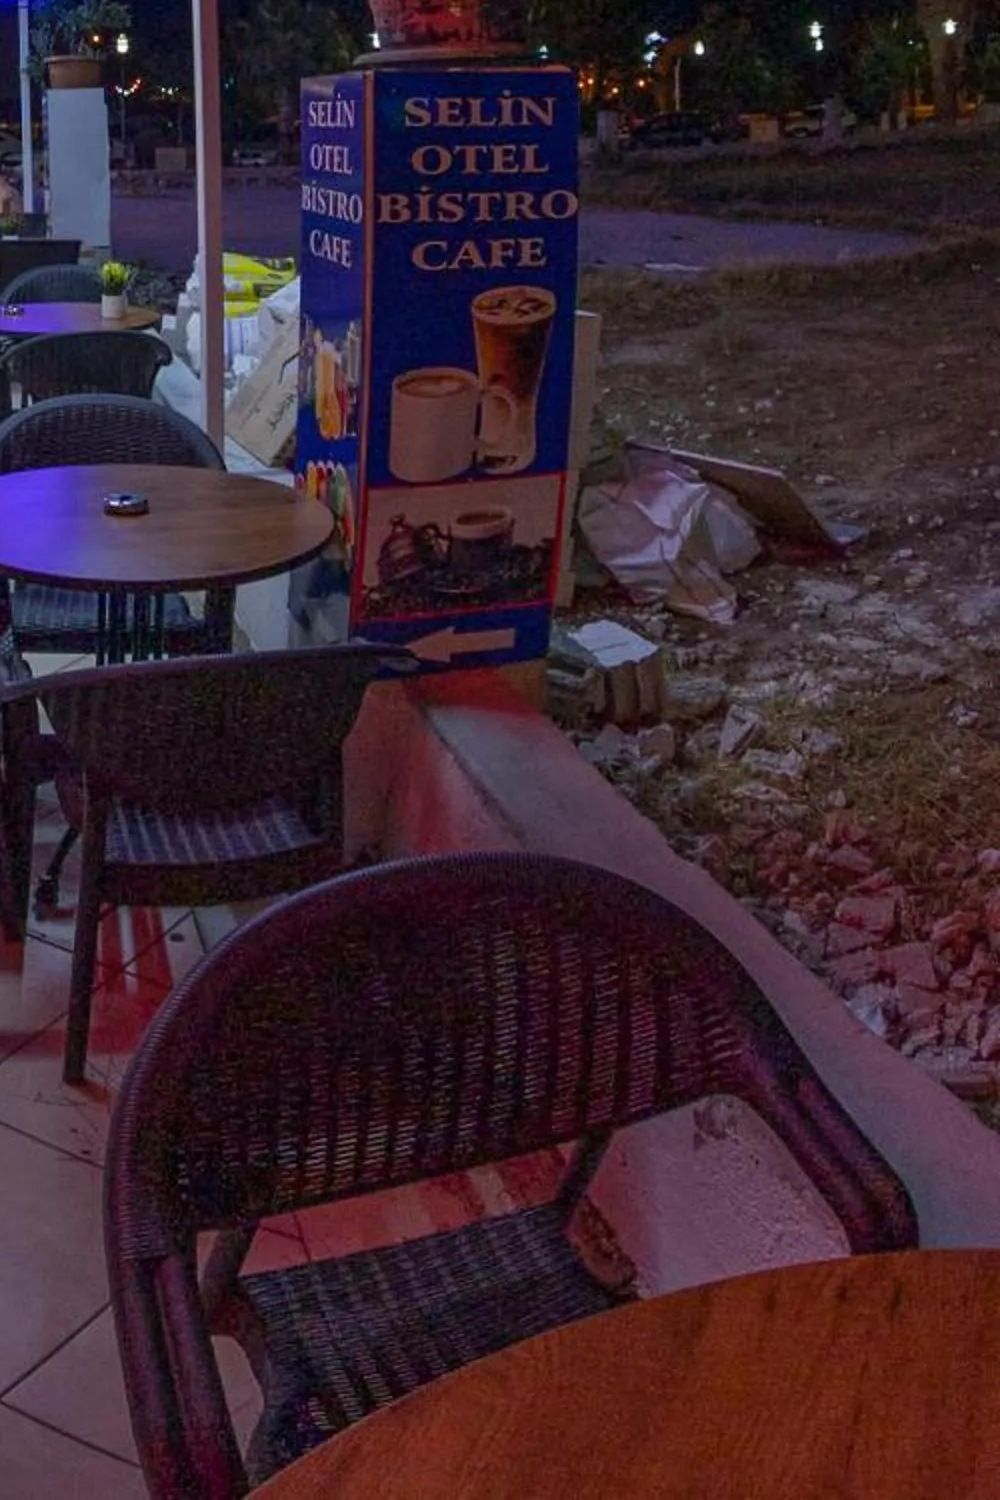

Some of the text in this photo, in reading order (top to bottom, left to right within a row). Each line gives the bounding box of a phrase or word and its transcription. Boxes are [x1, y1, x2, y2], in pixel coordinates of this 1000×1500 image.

[308, 93, 355, 128] SELİN
[404, 90, 557, 127] SELİN
[310, 145, 353, 175] OTEL
[411, 144, 549, 175] OTEL
[301, 180, 363, 224] BİSTRO
[377, 185, 579, 224] BİSTRO
[309, 229, 352, 268] CAFE
[411, 238, 547, 271] CAFE
